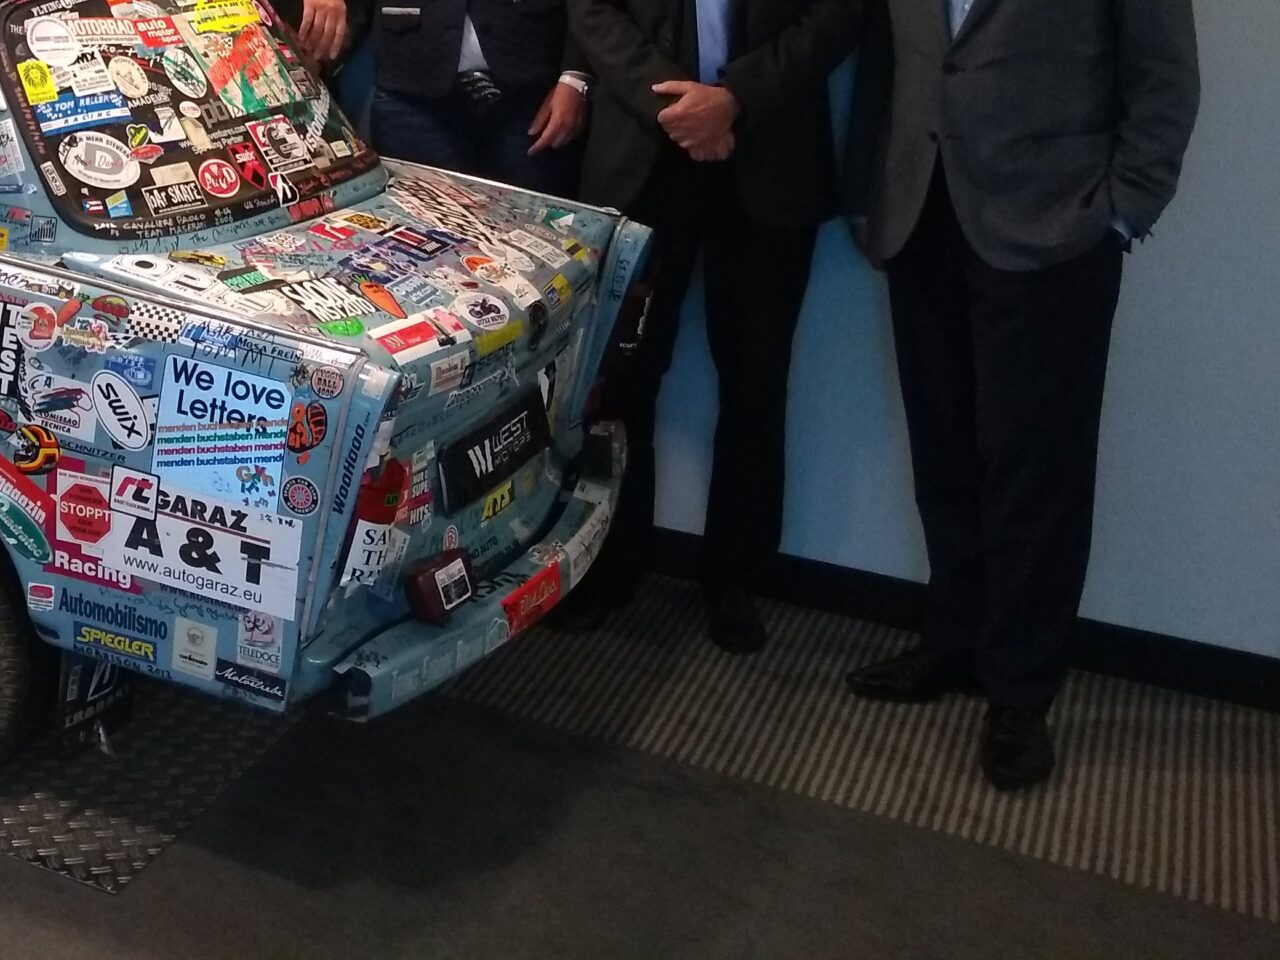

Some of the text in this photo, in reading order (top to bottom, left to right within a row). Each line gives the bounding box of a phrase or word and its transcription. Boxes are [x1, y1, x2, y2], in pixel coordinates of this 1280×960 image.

[137, 19, 168, 31] auto
[55, 100, 76, 112] TOM
[63, 110, 112, 125] RACING
[172, 357, 285, 410] We love
[176, 388, 268, 435] Letters
[157, 433, 196, 445] menden
[197, 431, 253, 444] buchstaben
[158, 423, 196, 433] menden
[157, 445, 196, 456] menden
[196, 442, 253, 455] buchstaben
[156, 456, 196, 468] menden
[196, 453, 253, 467] buchstaben
[60, 501, 112, 522] STOPPT
[124, 518, 271, 586] A & T
[54, 551, 132, 589] Racing
[123, 553, 263, 605] www.autogaraz.eu
[58, 587, 168, 640] Automobilismo
[76, 625, 154, 662] SPIEGLER
